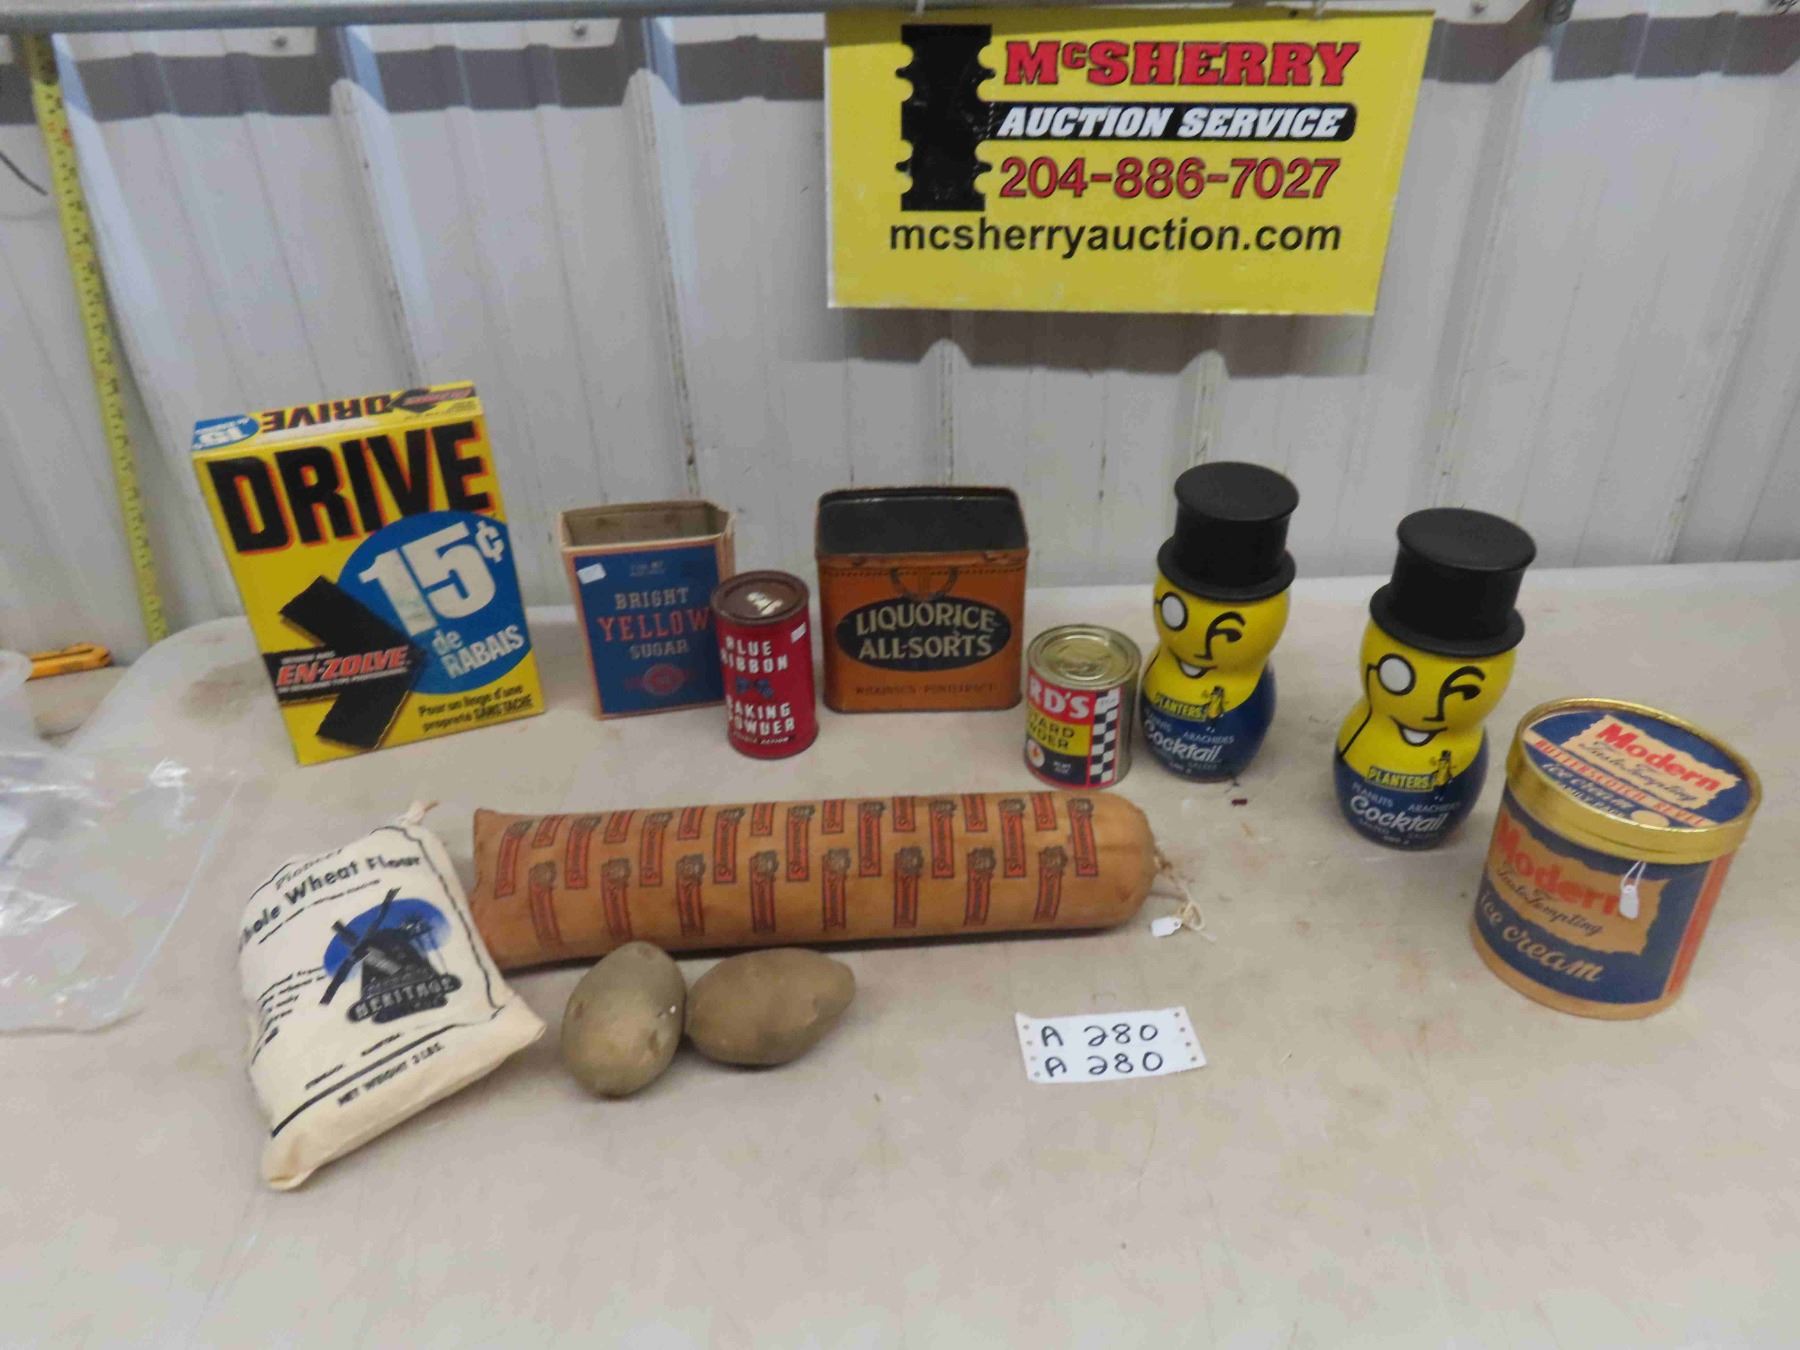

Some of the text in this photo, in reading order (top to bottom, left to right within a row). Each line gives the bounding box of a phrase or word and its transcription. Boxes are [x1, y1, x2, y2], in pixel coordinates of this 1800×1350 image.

[997, 106, 1348, 138] AUCTION SERVICE
[999, 156, 1341, 200] 204-886-7027
[888, 217, 1342, 259] mcsherryauction.com
[261, 394, 394, 433] DRIVE
[206, 421, 496, 555] DRIVE
[614, 587, 689, 610] BRIGHT
[596, 607, 710, 642] YELLOW
[856, 602, 996, 637] LIQUORICE
[432, 629, 463, 656] de
[441, 624, 524, 679] RABAIS
[629, 639, 690, 660] SUGAR
[276, 645, 409, 686] EN-ZOLVE
[1597, 722, 1720, 792] Modern
[1368, 766, 1434, 791] PLANTERS
[1350, 794, 1450, 833] Cocktail
[284, 861, 360, 905] Wheat
[1041, 1023, 1158, 1047] A 280
[1044, 1051, 1163, 1078] A 280
